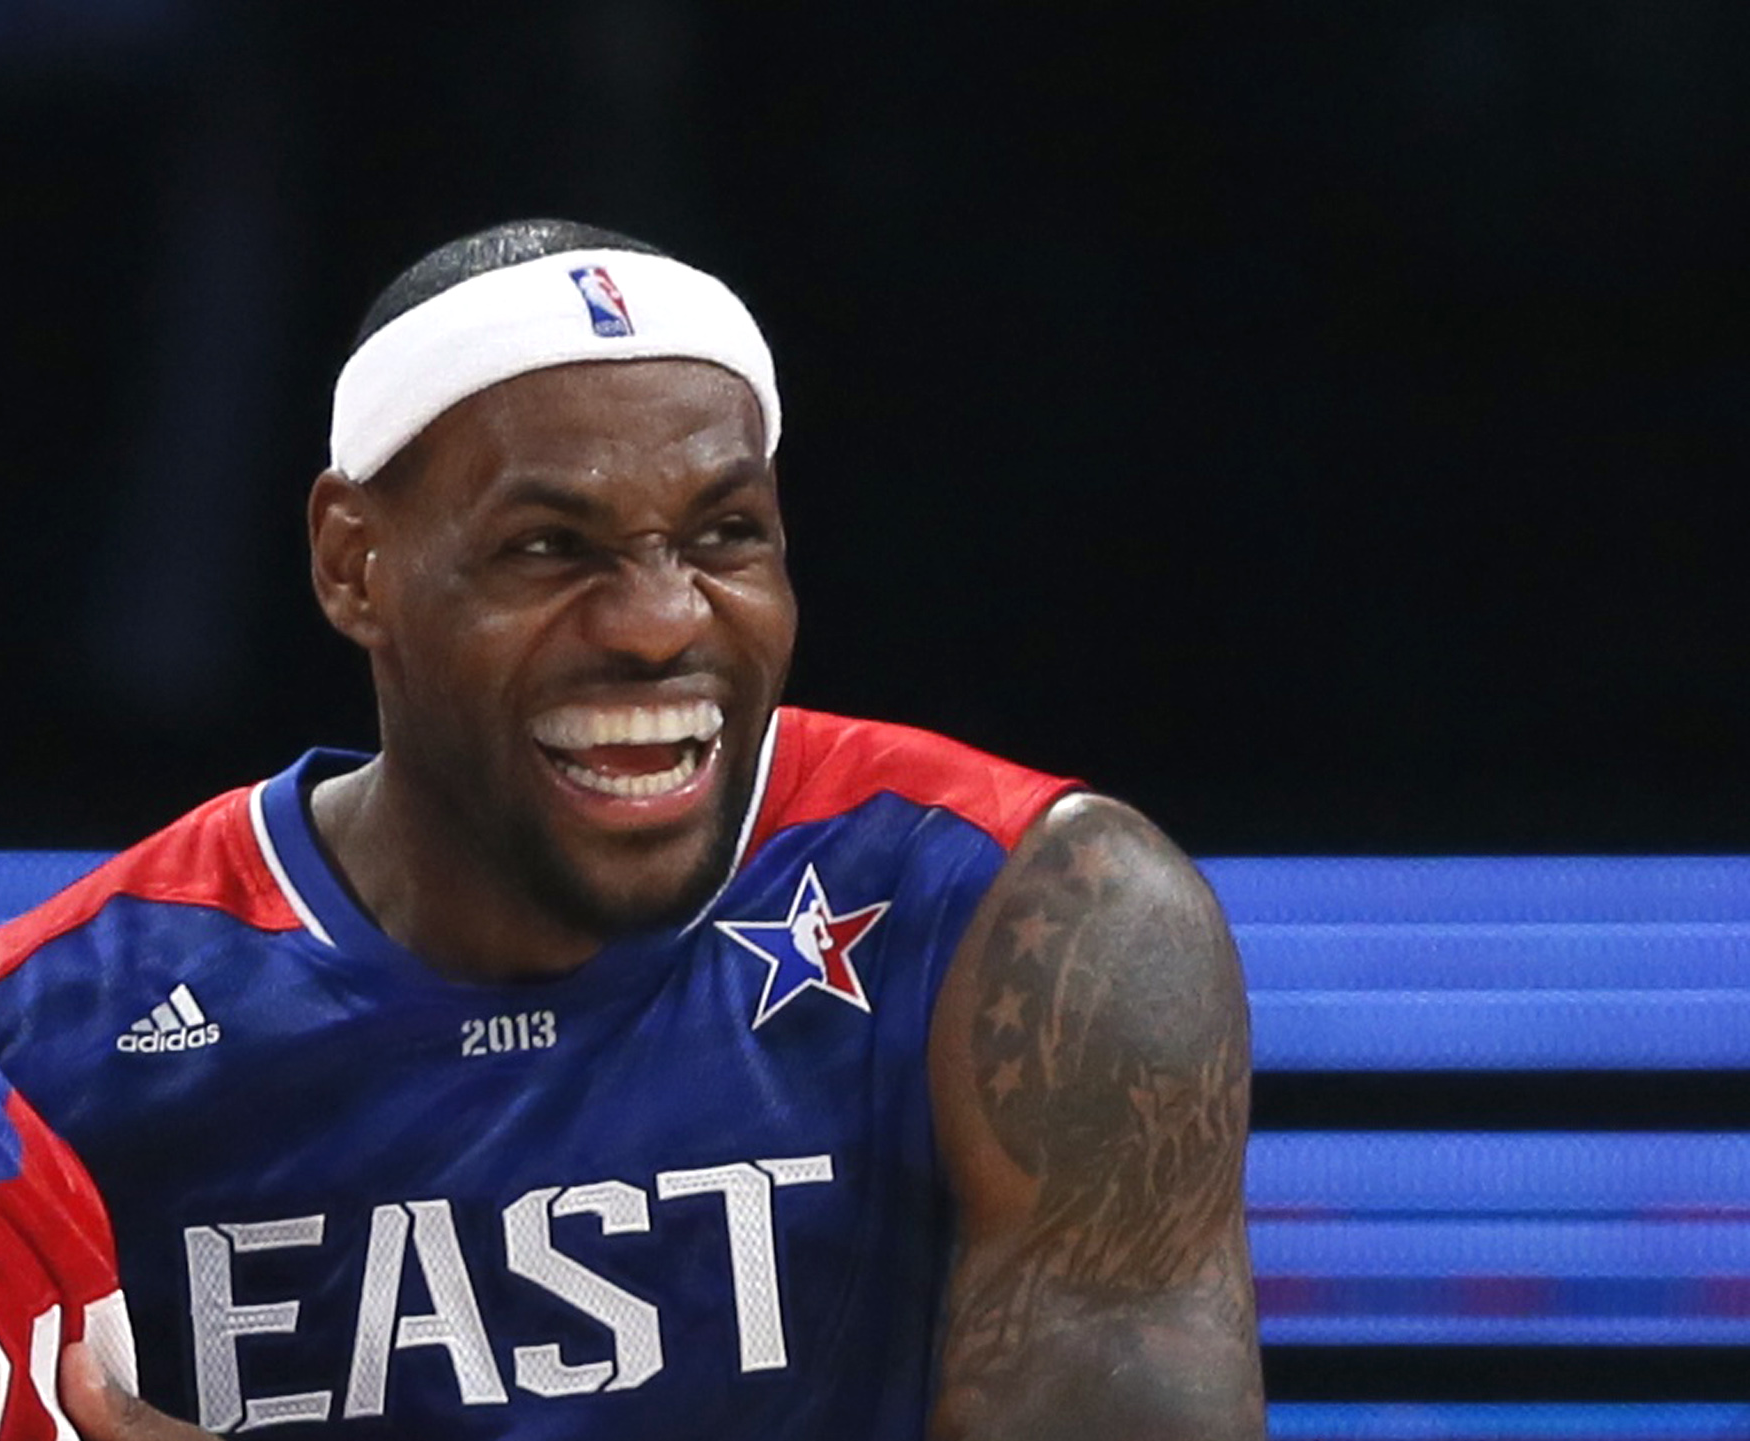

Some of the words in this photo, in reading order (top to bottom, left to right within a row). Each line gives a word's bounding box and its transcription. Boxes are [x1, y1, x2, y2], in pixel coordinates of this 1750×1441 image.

[116, 1023, 220, 1052] adidas
[461, 1011, 556, 1056] 2013
[184, 1155, 834, 1434] EAST
